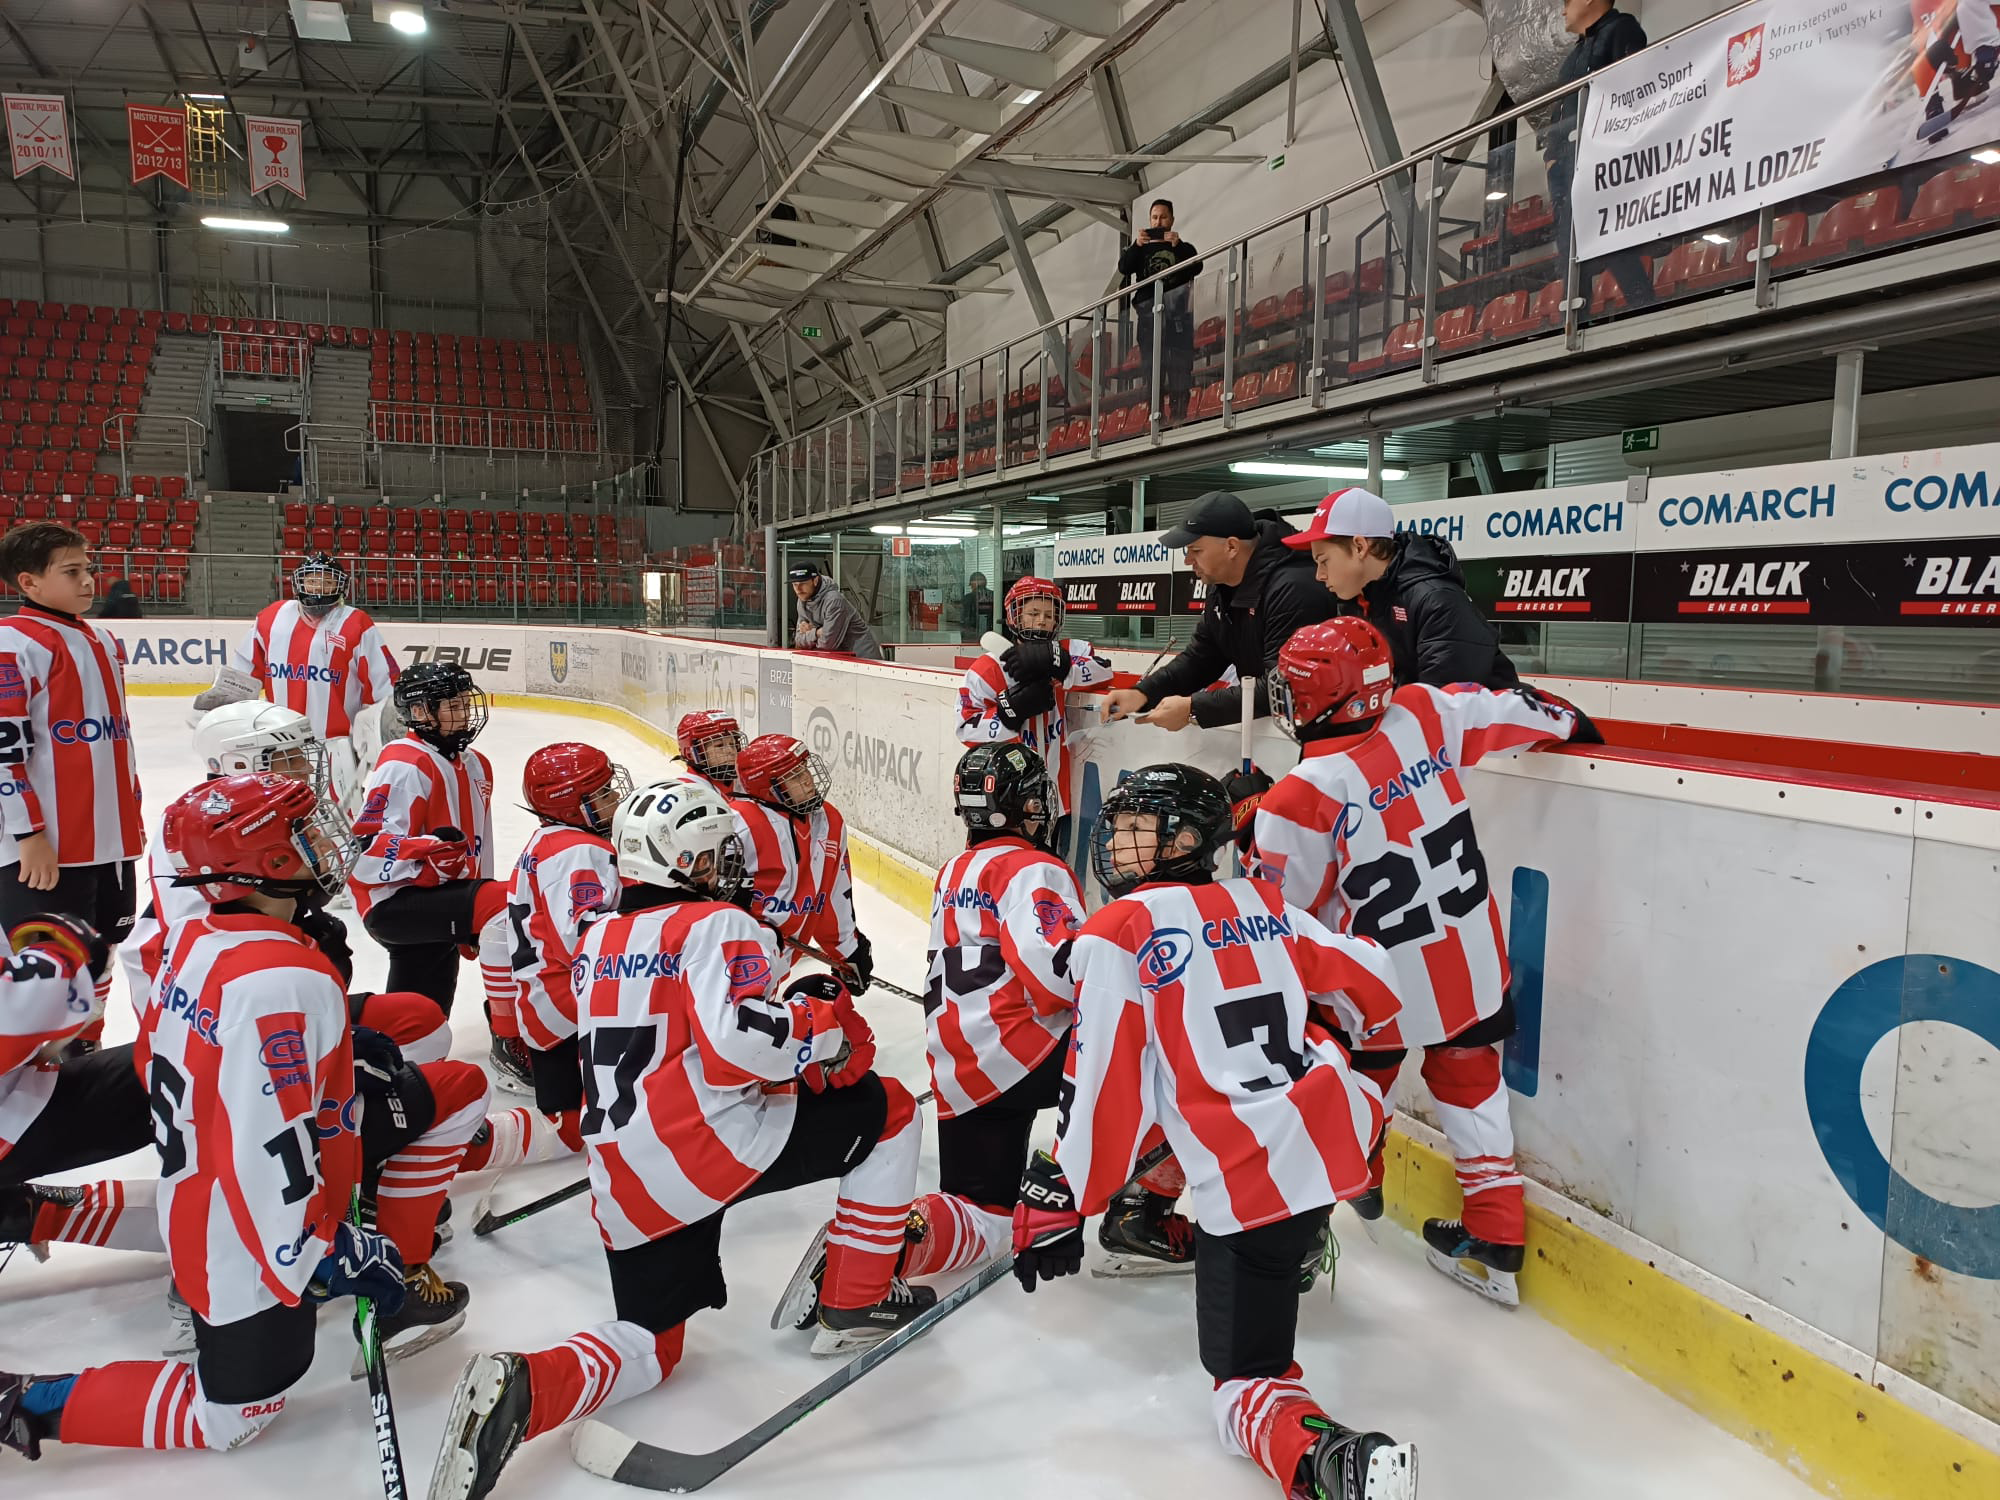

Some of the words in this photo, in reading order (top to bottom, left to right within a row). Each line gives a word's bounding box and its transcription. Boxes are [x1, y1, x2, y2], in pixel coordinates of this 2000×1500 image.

[1770, 2, 1848, 40] Ministerstwo
[1768, 40, 1813, 61] Sportu
[1818, 34, 1824, 45] i
[1825, 8, 1883, 42] Turystyki
[1609, 80, 1657, 110] Program
[1657, 61, 1694, 91] Sport
[10, 102, 35, 112] MISTRZ
[36, 102, 60, 112] POLSKI
[1603, 97, 1667, 135] Wszystkich
[1668, 79, 1708, 108] Dzieci
[133, 112, 158, 122] MISTRZ
[158, 115, 182, 126] POLSKI
[250, 123, 275, 134] PUCHAR
[275, 125, 298, 136] POLSKI
[17, 144, 64, 158] 2010/11
[136, 153, 182, 170] 2012/13
[1594, 133, 1696, 192] ROZWIJAJ
[1698, 118, 1733, 158] SIĘ
[264, 165, 290, 178] 2013
[1598, 208, 1609, 237] Z
[1615, 177, 1702, 232] HOKEJEM
[1707, 167, 1737, 203] NA
[1743, 138, 1826, 192] LODZIE
[1658, 484, 1836, 526] COMARCH
[1486, 502, 1624, 538] COMARCH
[1057, 548, 1105, 566] COMARCH
[1114, 544, 1169, 564] COMARCH
[1504, 567, 1591, 597] BLACK
[1689, 561, 1811, 597] BLACK
[1067, 584, 1098, 601] BLACK
[1120, 582, 1157, 600] BLACK
[1516, 602, 1564, 611] ENERGY
[1707, 603, 1772, 612] ENERGY
[1369, 693, 1379, 710] 6
[843, 730, 923, 794] CANPACK
[657, 793, 679, 815] 6
[1341, 808, 1489, 950] 23
[578, 1024, 658, 1136] 17
